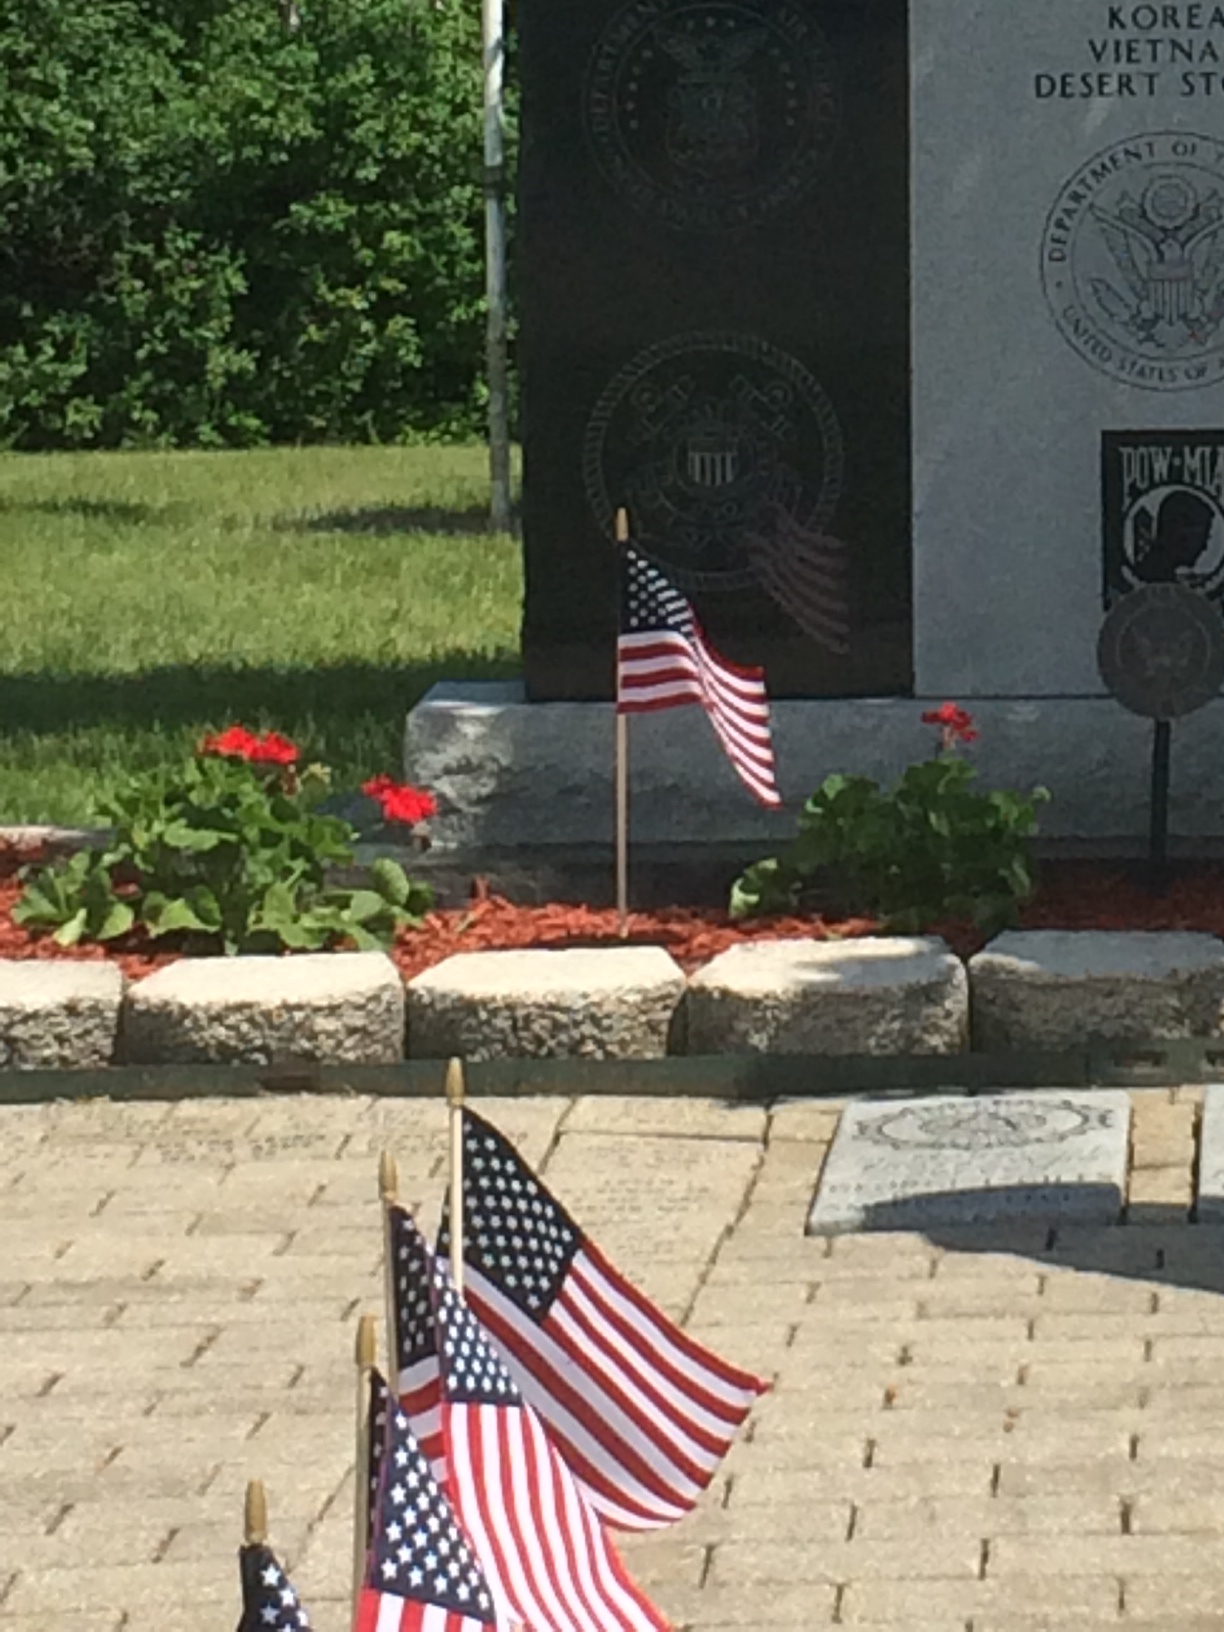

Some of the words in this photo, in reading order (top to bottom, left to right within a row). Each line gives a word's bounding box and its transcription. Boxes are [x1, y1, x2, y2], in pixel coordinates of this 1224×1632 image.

[1035, 72, 1160, 98] DESERT
[1048, 142, 1156, 263] DEPARTMENT
[1171, 141, 1197, 157] OF
